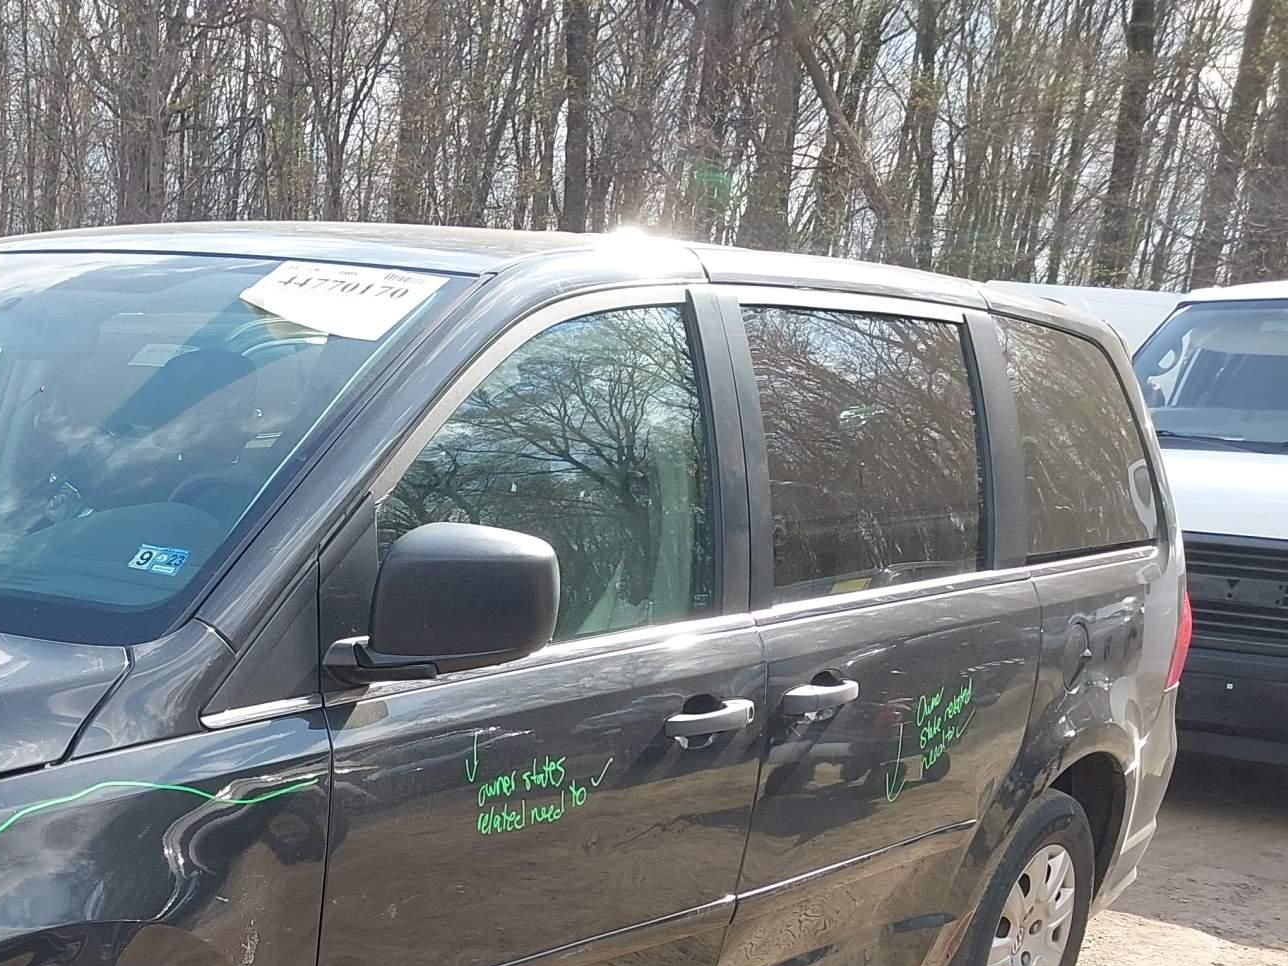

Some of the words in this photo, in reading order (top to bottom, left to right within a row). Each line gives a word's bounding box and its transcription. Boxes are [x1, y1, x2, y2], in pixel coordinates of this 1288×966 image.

[278, 275, 409, 299] 44770170
[135, 550, 154, 566] 9
[522, 755, 568, 792] states
[477, 800, 526, 835] related
[530, 791, 566, 825] need
[569, 780, 588, 807] to
